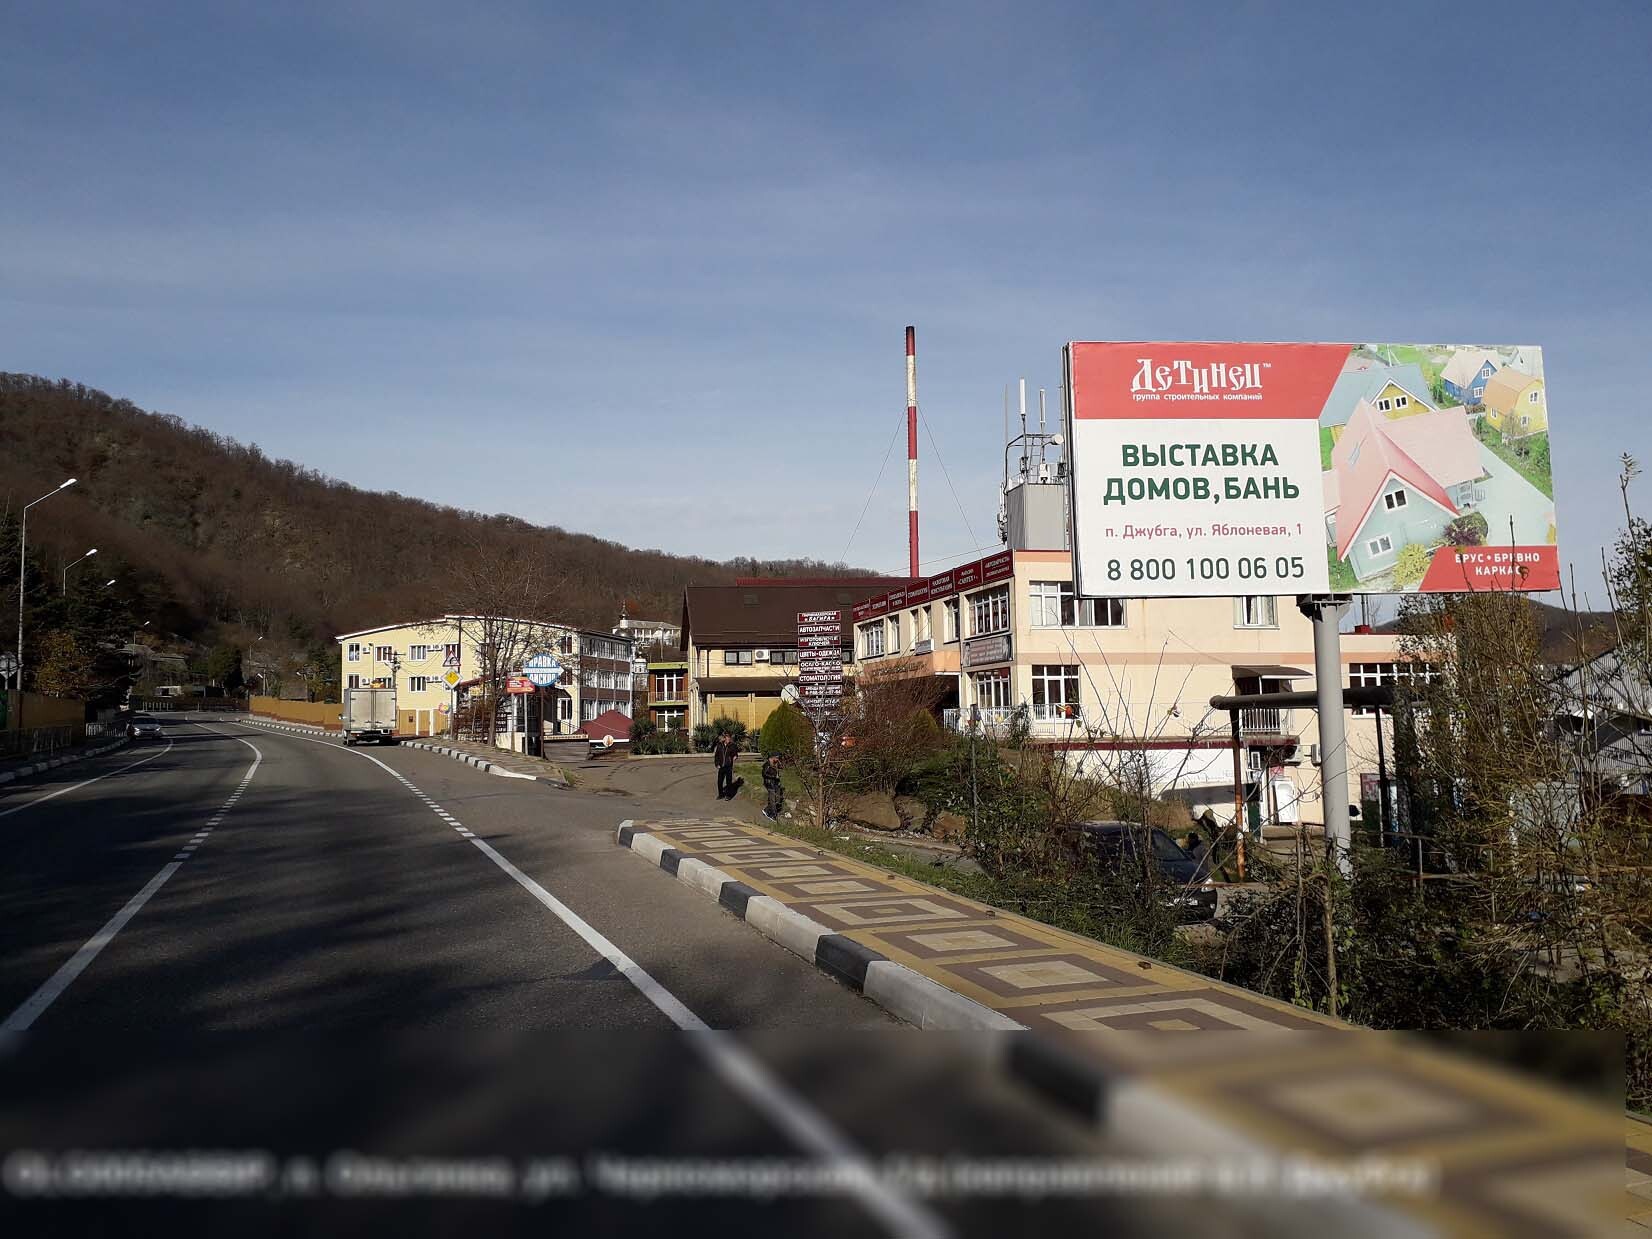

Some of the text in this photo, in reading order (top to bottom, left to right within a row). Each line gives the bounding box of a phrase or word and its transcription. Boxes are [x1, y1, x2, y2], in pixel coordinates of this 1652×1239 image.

[1132, 392, 1263, 402] группа строительных компаний
[1121, 443, 1279, 467] ВЫСТАВКА
[1105, 523, 1303, 540] п. Джубга, ул. Яблоневая, 1
[1106, 557, 1304, 581] 8 800 100 06 05
[799, 625, 840, 633] АВТОЗАПЧАСТИ
[799, 674, 841, 682] СТОМАТОЛОГИЯ
